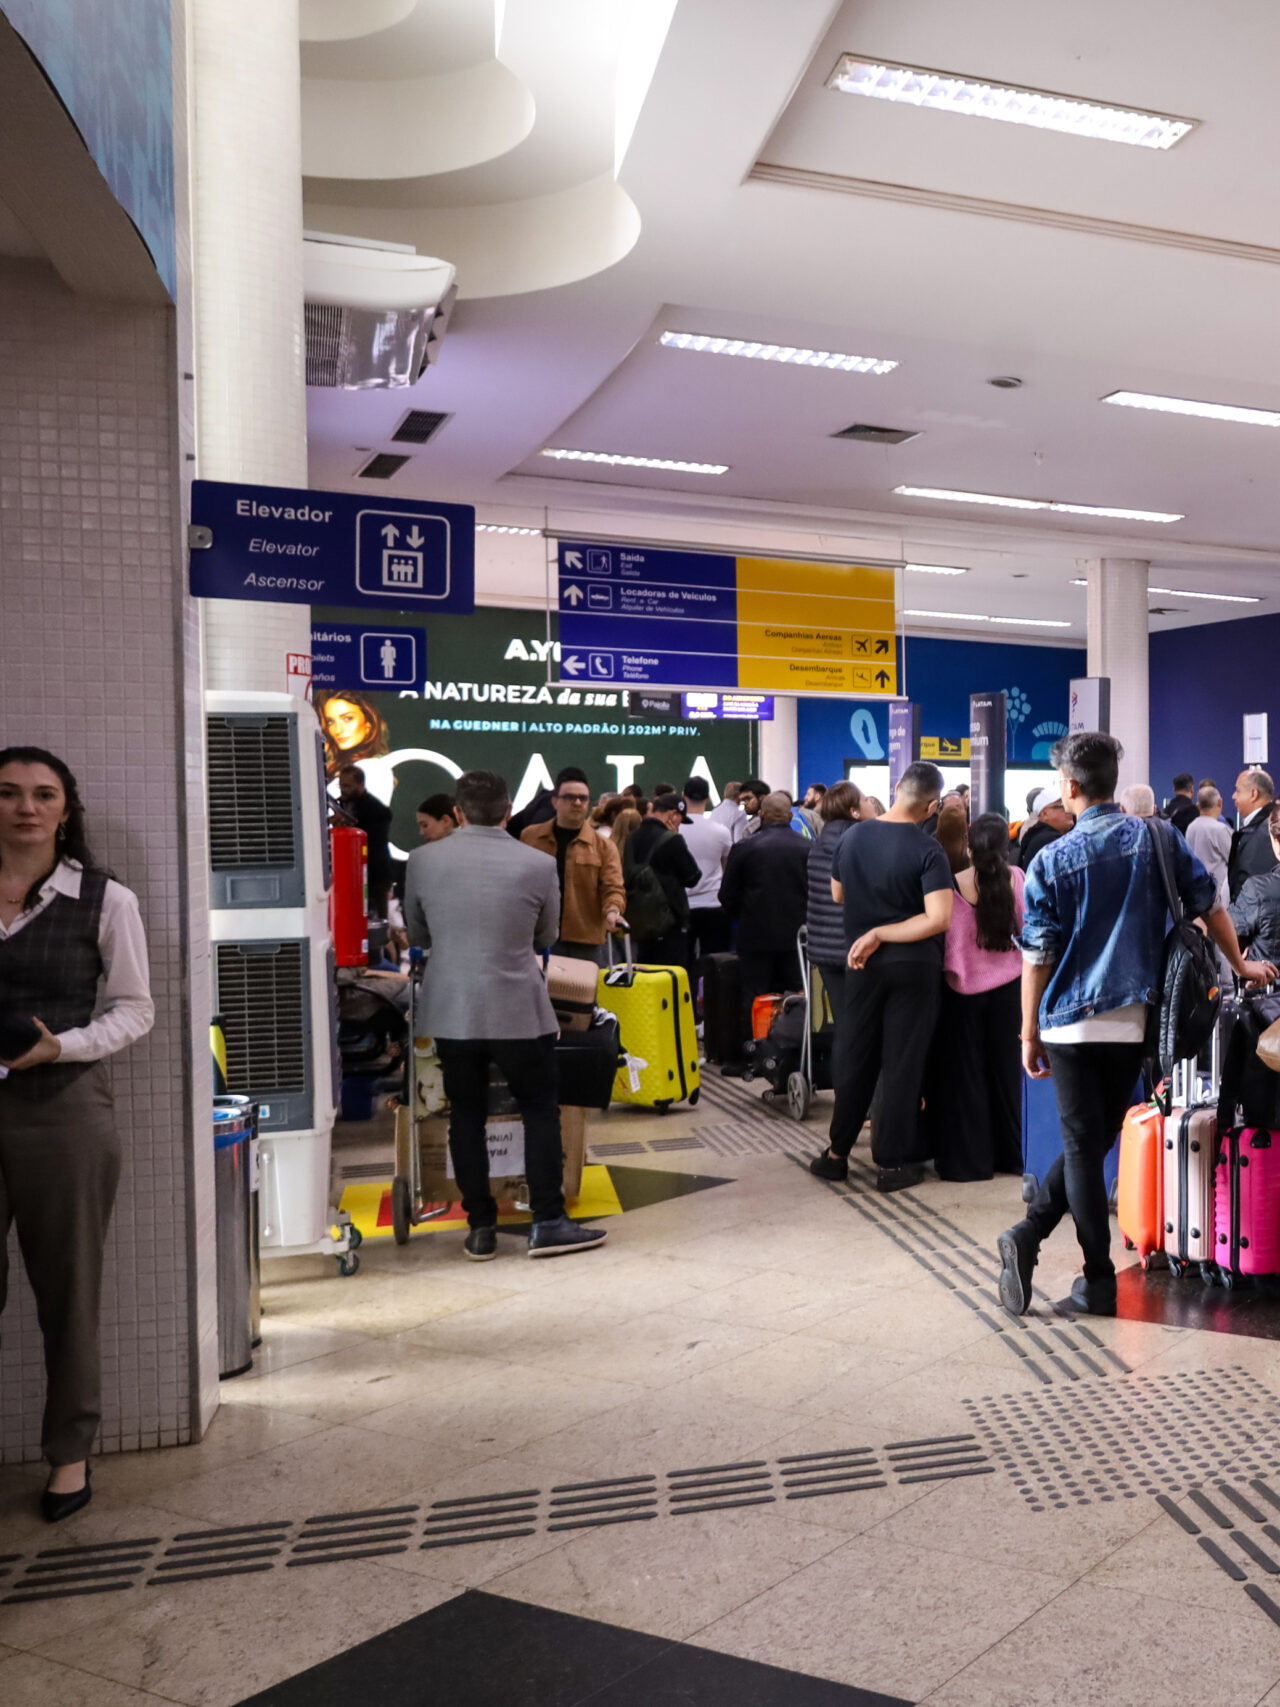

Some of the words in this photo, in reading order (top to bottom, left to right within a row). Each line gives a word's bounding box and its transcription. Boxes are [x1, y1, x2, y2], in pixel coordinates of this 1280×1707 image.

[236, 500, 333, 523] Elevador
[248, 538, 319, 557] Elevator
[243, 572, 325, 591] Ascensor
[620, 587, 666, 599] Locadoras
[668, 590, 679, 599] de
[765, 629, 814, 640] Companhias
[622, 655, 660, 666] Telefone
[789, 664, 843, 675] Desembarque
[424, 681, 553, 705] NATUREZA
[557, 688, 581, 706] da
[584, 691, 618, 707] sua
[430, 719, 451, 730] NA
[453, 719, 519, 732] GUEDNER
[528, 722, 563, 734] ALTO
[565, 722, 620, 735] PADRÃO
[668, 726, 701, 737] PRIV.
